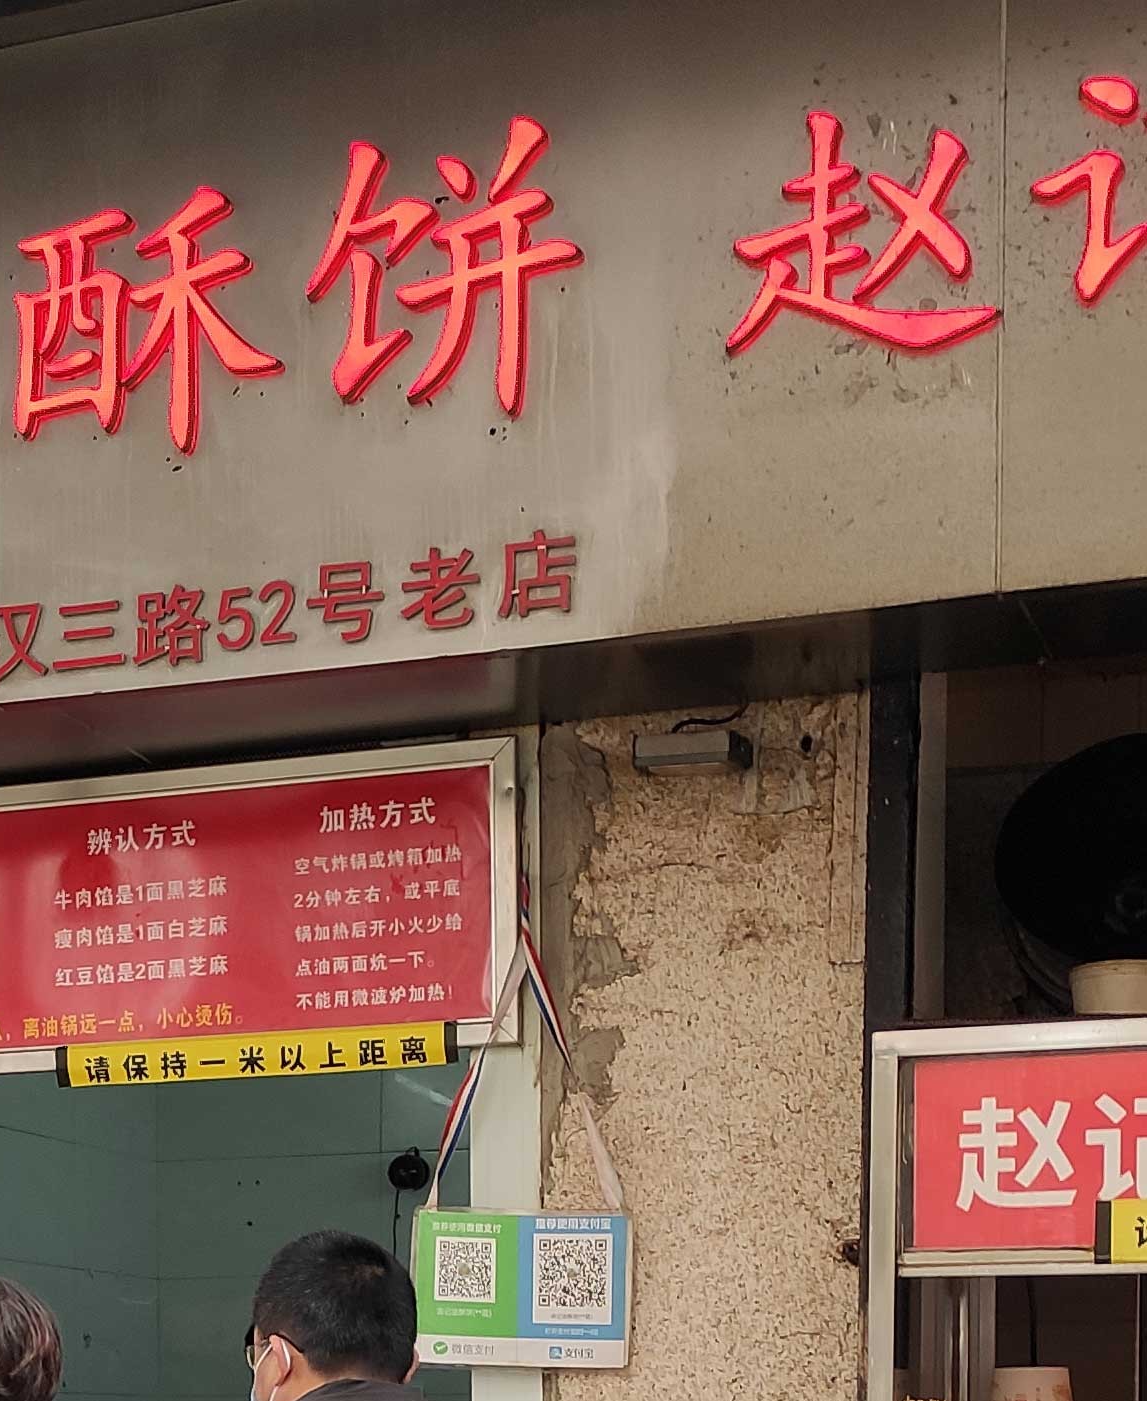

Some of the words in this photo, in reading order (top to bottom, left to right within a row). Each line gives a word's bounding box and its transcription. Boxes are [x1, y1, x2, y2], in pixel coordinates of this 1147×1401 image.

[319, 797, 437, 834] 加热方式
[87, 820, 196, 856] 辨认方式
[294, 844, 462, 875] 空气炸锅或烤箱加热
[54, 875, 227, 910] 牛肉馅是1面黑芝麻
[54, 915, 228, 949] 瘦肉馅是1面白芝麻
[295, 913, 463, 943] 锅加热后开小火少给
[55, 954, 228, 987] 红豆馅是2面黑芝麻
[295, 950, 435, 977] 点油两面炕一下。
[85, 1036, 428, 1084] 请保持一米以上距离
[452, 1344, 495, 1356] 微信支付
[564, 1347, 594, 1360] 支付宝
